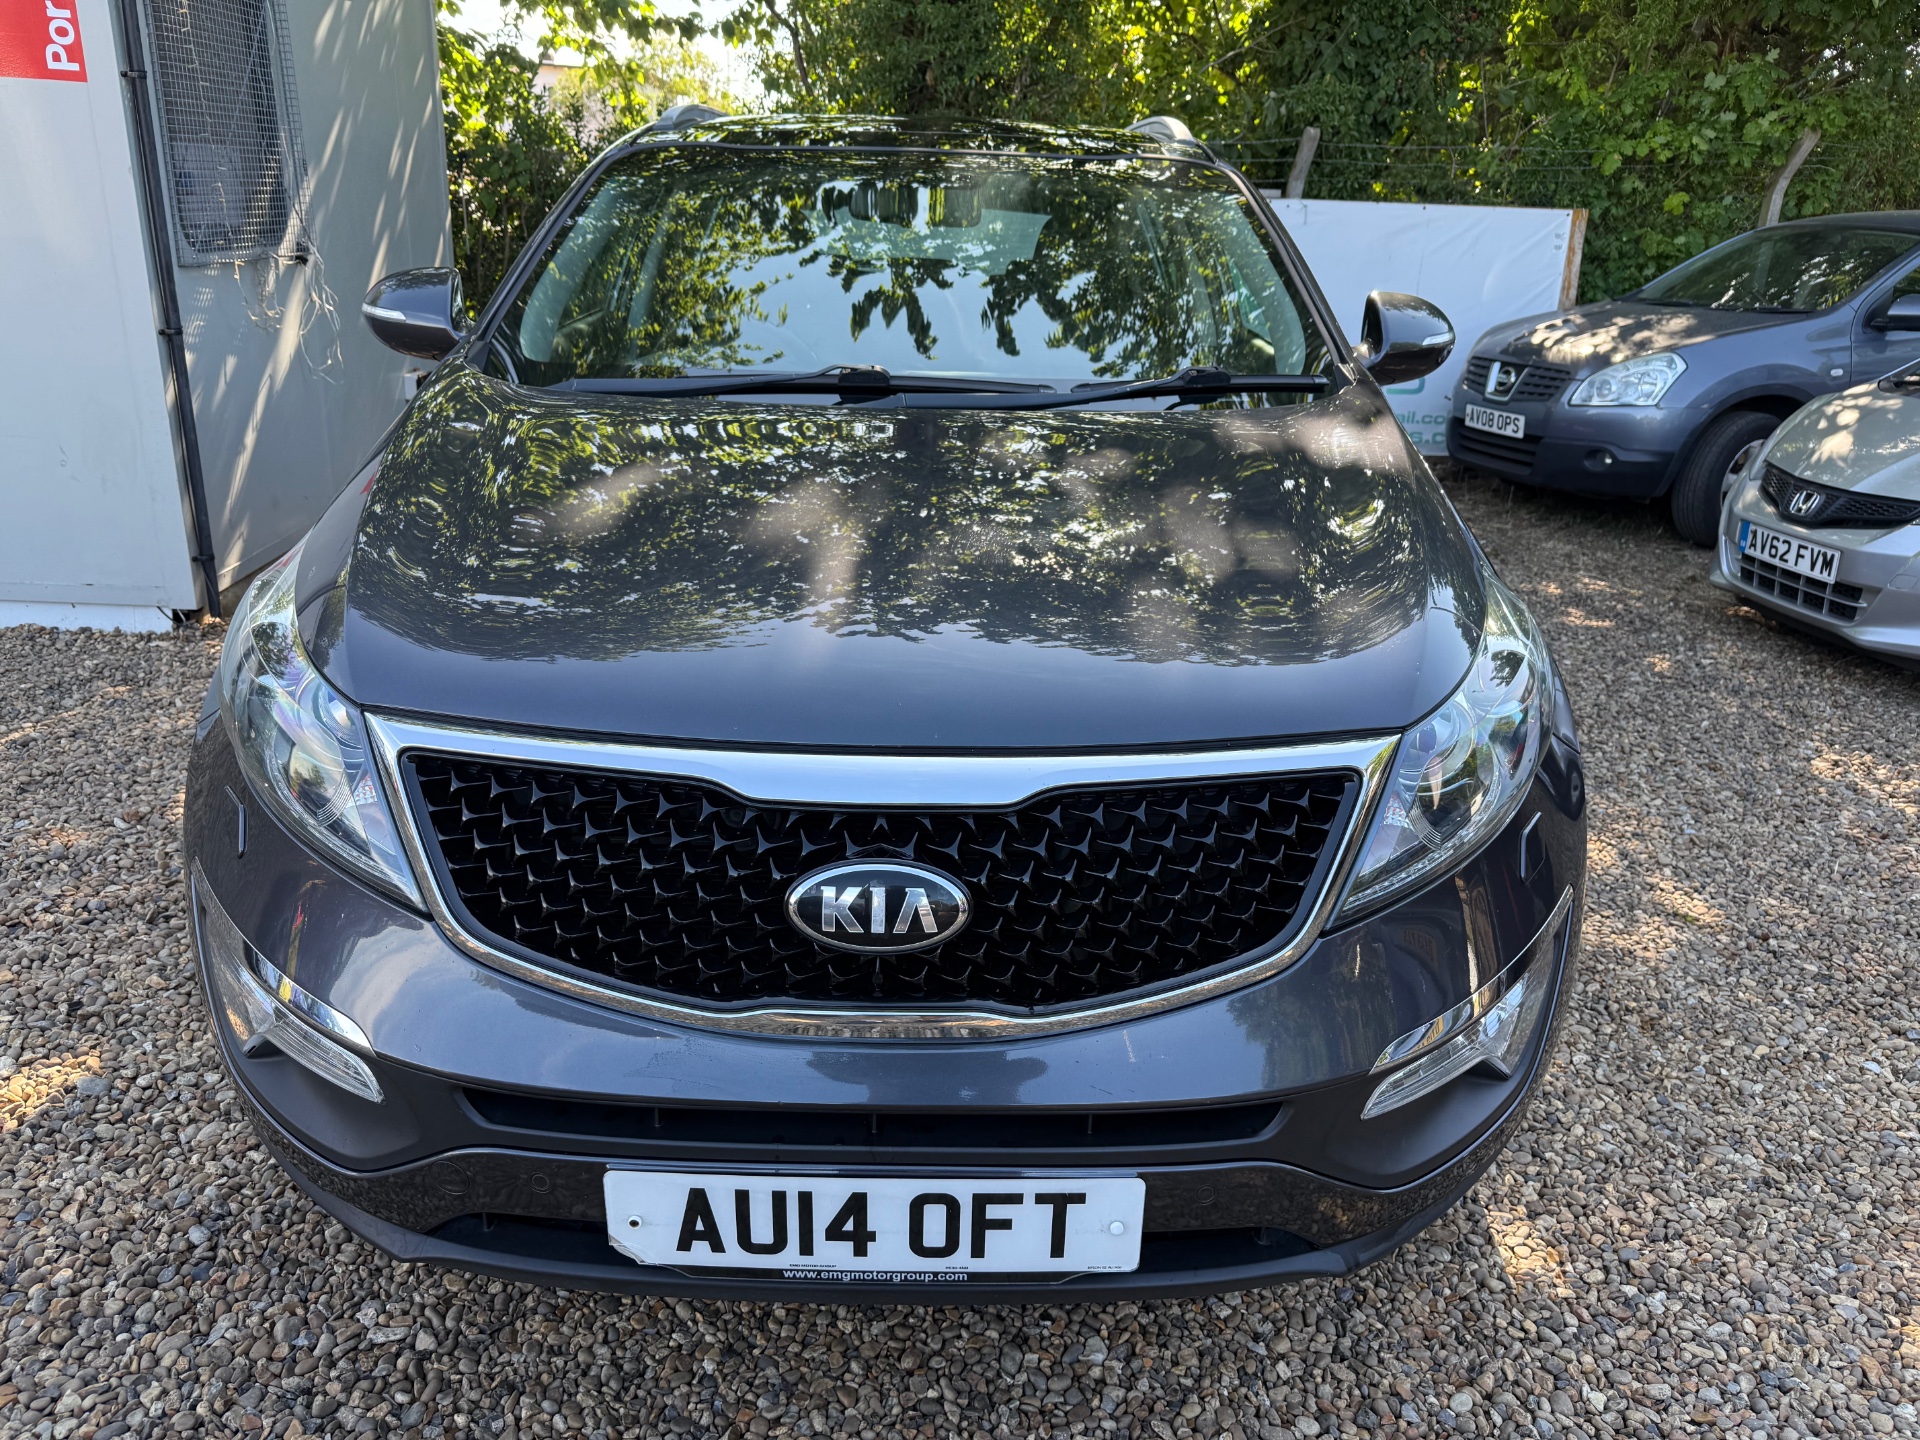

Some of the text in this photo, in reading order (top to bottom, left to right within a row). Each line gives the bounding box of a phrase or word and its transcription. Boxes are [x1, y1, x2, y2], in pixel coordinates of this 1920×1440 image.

[45, 0, 80, 71] Por
[1469, 407, 1520, 434] AV08 OPS
[1748, 528, 1836, 577] AV62 FVM
[820, 885, 938, 933] KIA
[675, 1187, 1087, 1259] AU14 OFT
[783, 1269, 968, 1283] www.emgmotorgroup.com
